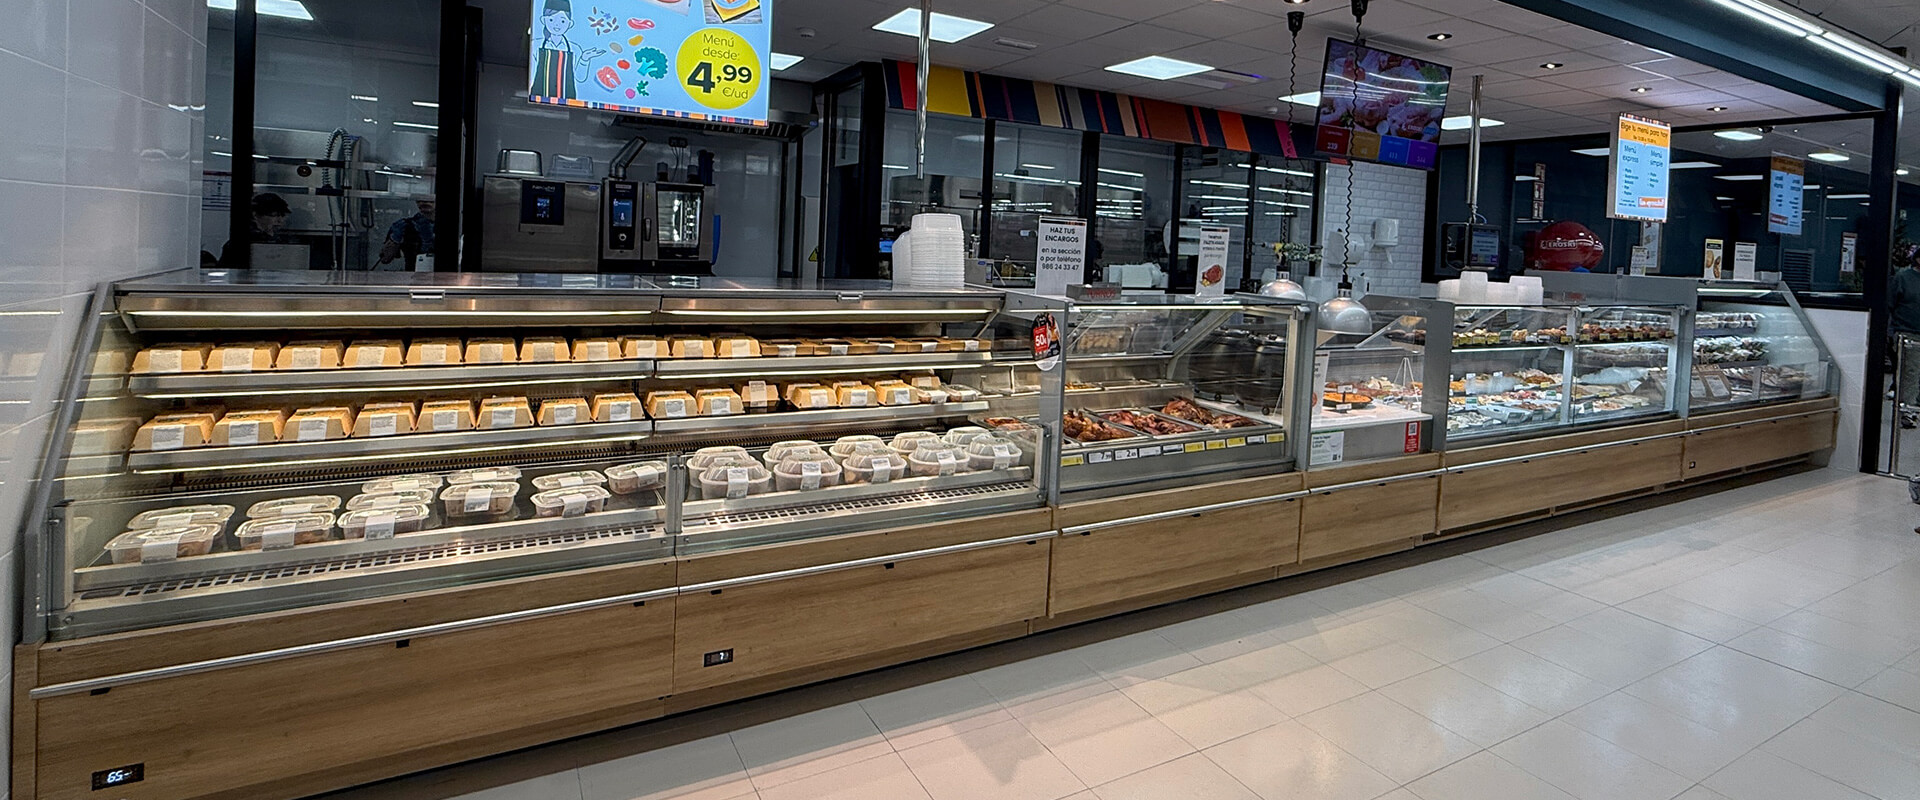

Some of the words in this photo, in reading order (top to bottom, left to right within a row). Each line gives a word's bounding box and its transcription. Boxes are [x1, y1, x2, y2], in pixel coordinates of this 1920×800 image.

[703, 33, 735, 48] Menú
[702, 47, 740, 61] desde:
[687, 61, 752, 94] 4,99
[722, 86, 749, 99] €/ud
[1637, 125, 1649, 134] menú
[1624, 145, 1637, 154] Menú
[1045, 235, 1079, 243] ENCARGOS
